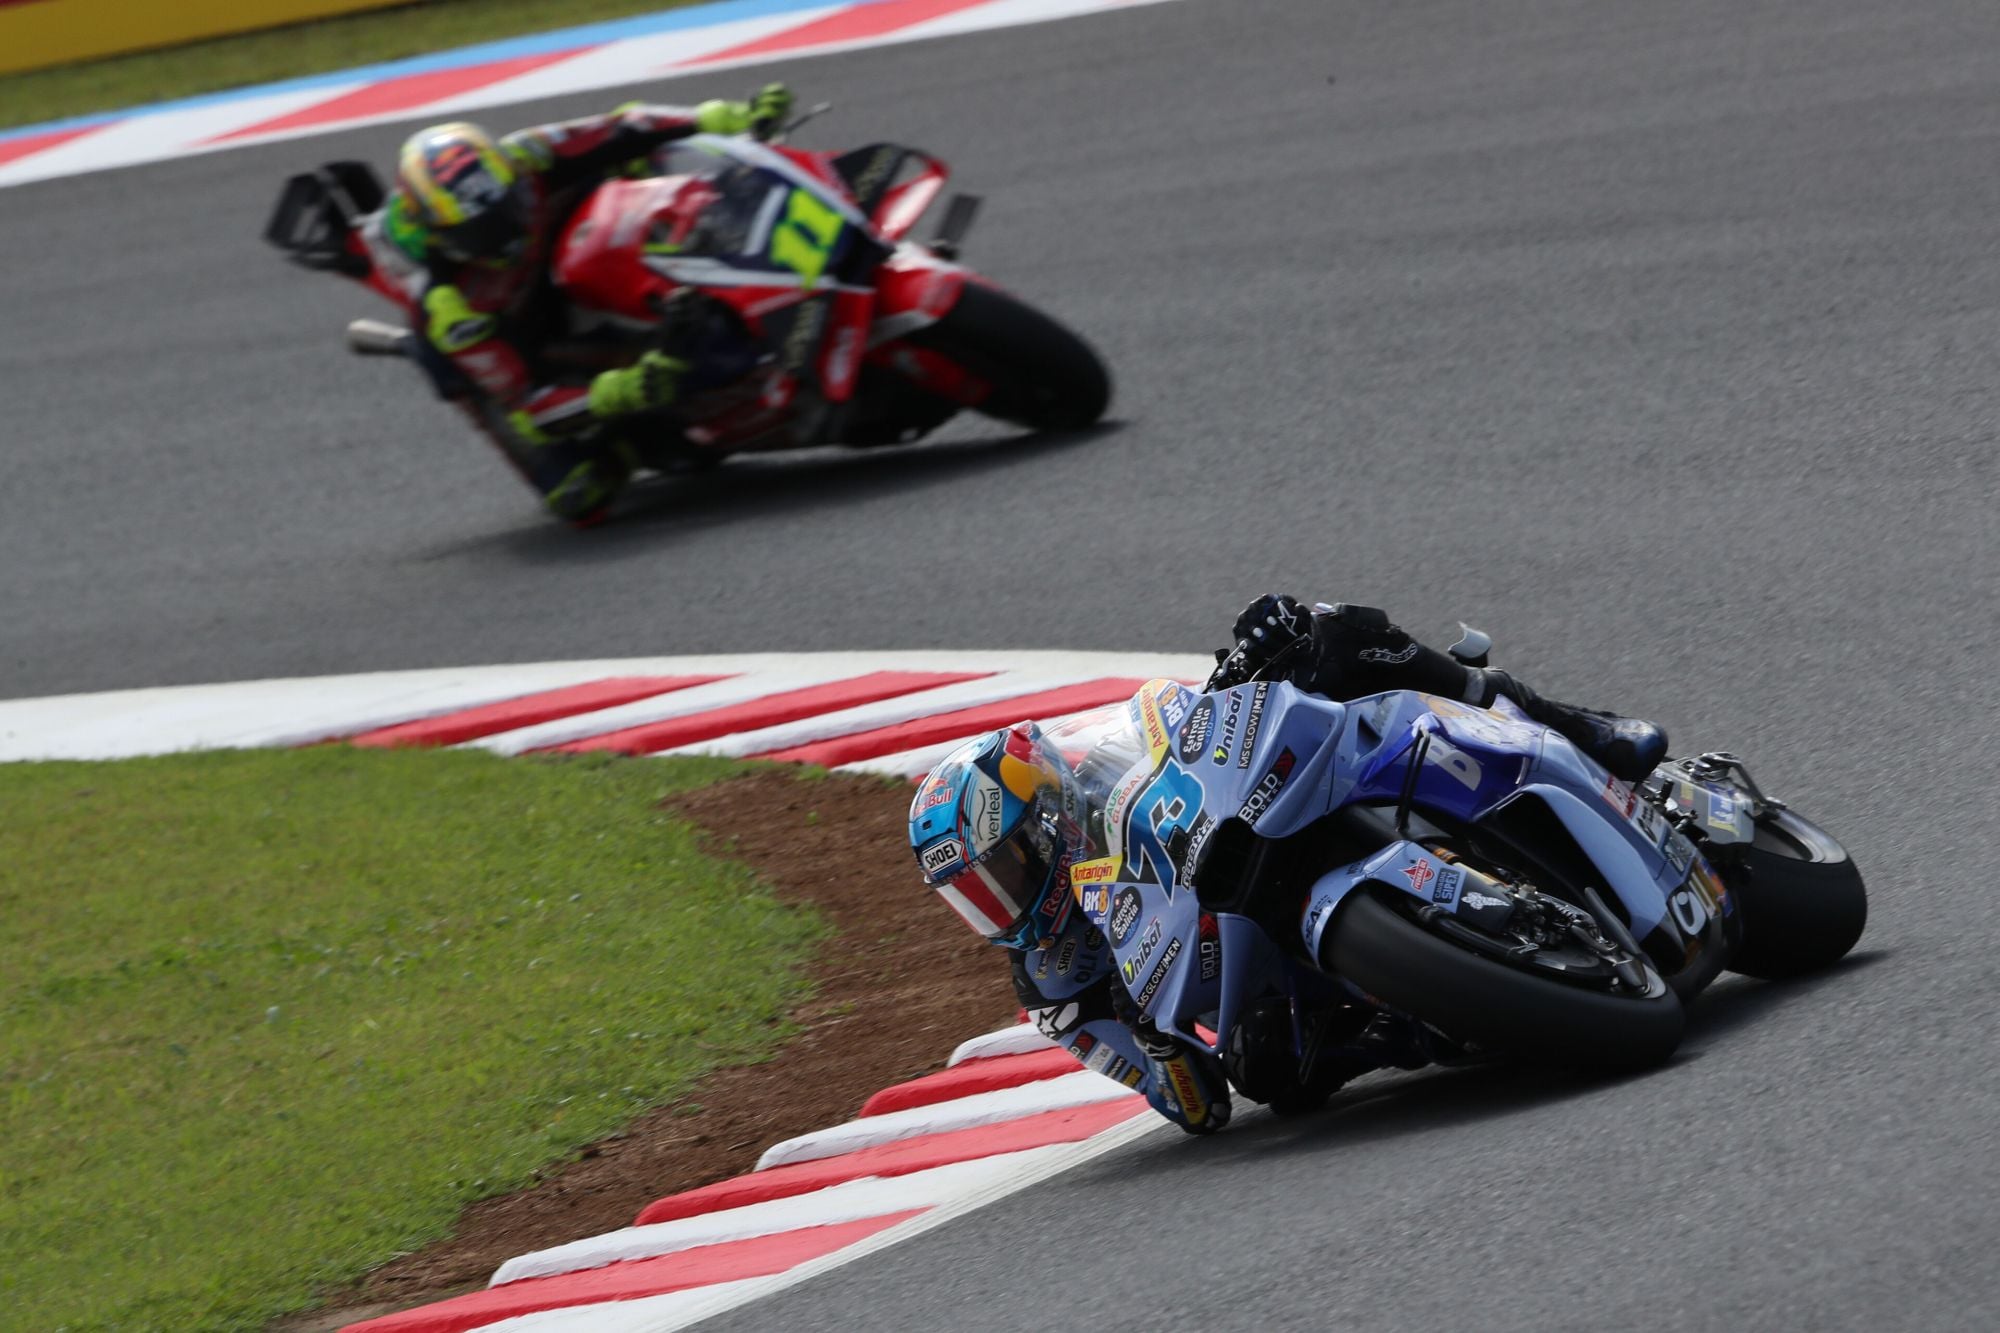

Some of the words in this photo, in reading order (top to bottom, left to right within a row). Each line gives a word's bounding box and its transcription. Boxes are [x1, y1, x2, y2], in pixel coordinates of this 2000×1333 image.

[1160, 685, 1186, 727] BK8
[1254, 682, 1268, 711] MEN
[1183, 707, 1204, 754] Estrella
[1192, 708, 1211, 752] Galicia
[1213, 689, 1244, 768] Unibat
[1244, 714, 1257, 752] GLOW
[1240, 751, 1250, 768] MS
[987, 787, 1000, 842] verleal
[1107, 788, 1122, 819] AUS
[1112, 773, 1145, 824] GLOBAL
[1238, 773, 1278, 823] BOLD
[1127, 756, 1205, 907] 73
[924, 842, 957, 869] SHOEI
[1073, 863, 1113, 882] Antangin
[1084, 886, 1109, 916] BK8
[1442, 872, 1457, 899] SIPEX
[1111, 893, 1134, 932] Estrella
[1116, 903, 1138, 940] Galicia
[1057, 942, 1077, 971] SHOEI
[1123, 918, 1162, 986] Unibat
[1146, 968, 1165, 995] GLOW
[1163, 939, 1181, 968] MEN
[1202, 942, 1215, 980] BOLD
